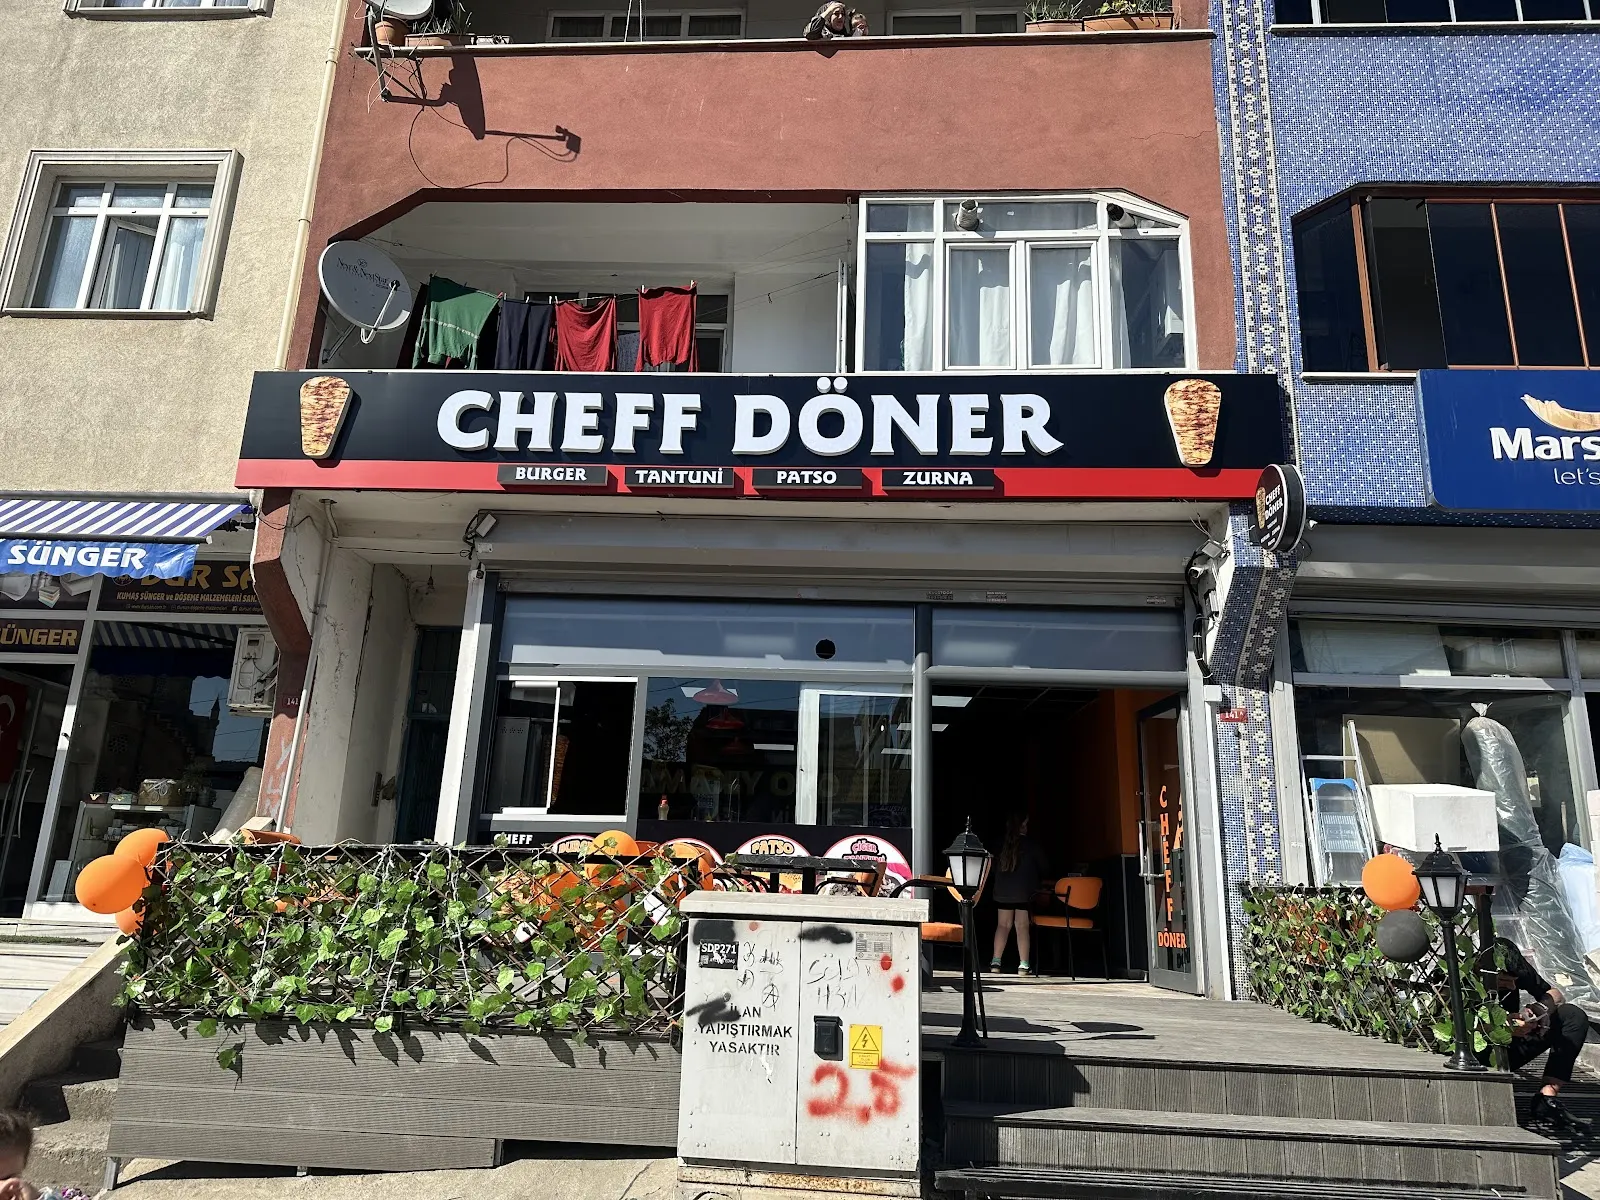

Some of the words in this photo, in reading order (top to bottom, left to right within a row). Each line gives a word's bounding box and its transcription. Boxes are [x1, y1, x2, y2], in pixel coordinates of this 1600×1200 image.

[437, 390, 702, 454] CHEFF
[732, 377, 1064, 456] DÖNER
[515, 467, 587, 481] BURGER
[635, 467, 724, 484] TANTUNİ
[776, 470, 837, 485] PATSO
[902, 471, 973, 485] ZURNA
[1265, 484, 1281, 505] CHEFF
[1264, 497, 1284, 520] DÖNER
[7, 541, 147, 570] SÜNGER
[116, 591, 140, 601] KUMAŞ
[140, 590, 165, 600] SÜNGER
[166, 593, 174, 601] ve
[174, 591, 200, 602] DÖŞEME
[0, 623, 78, 646] ÜNGER
[287, 697, 299, 706] 141
[751, 839, 795, 855] PATSO
[1160, 785, 1173, 921] CHEFF
[1157, 927, 1187, 949] DÖNER
[701, 943, 737, 954] SDP271
[698, 1022, 793, 1038] YAPIŞTIRMAK
[709, 1040, 781, 1056] YASAKTIR
